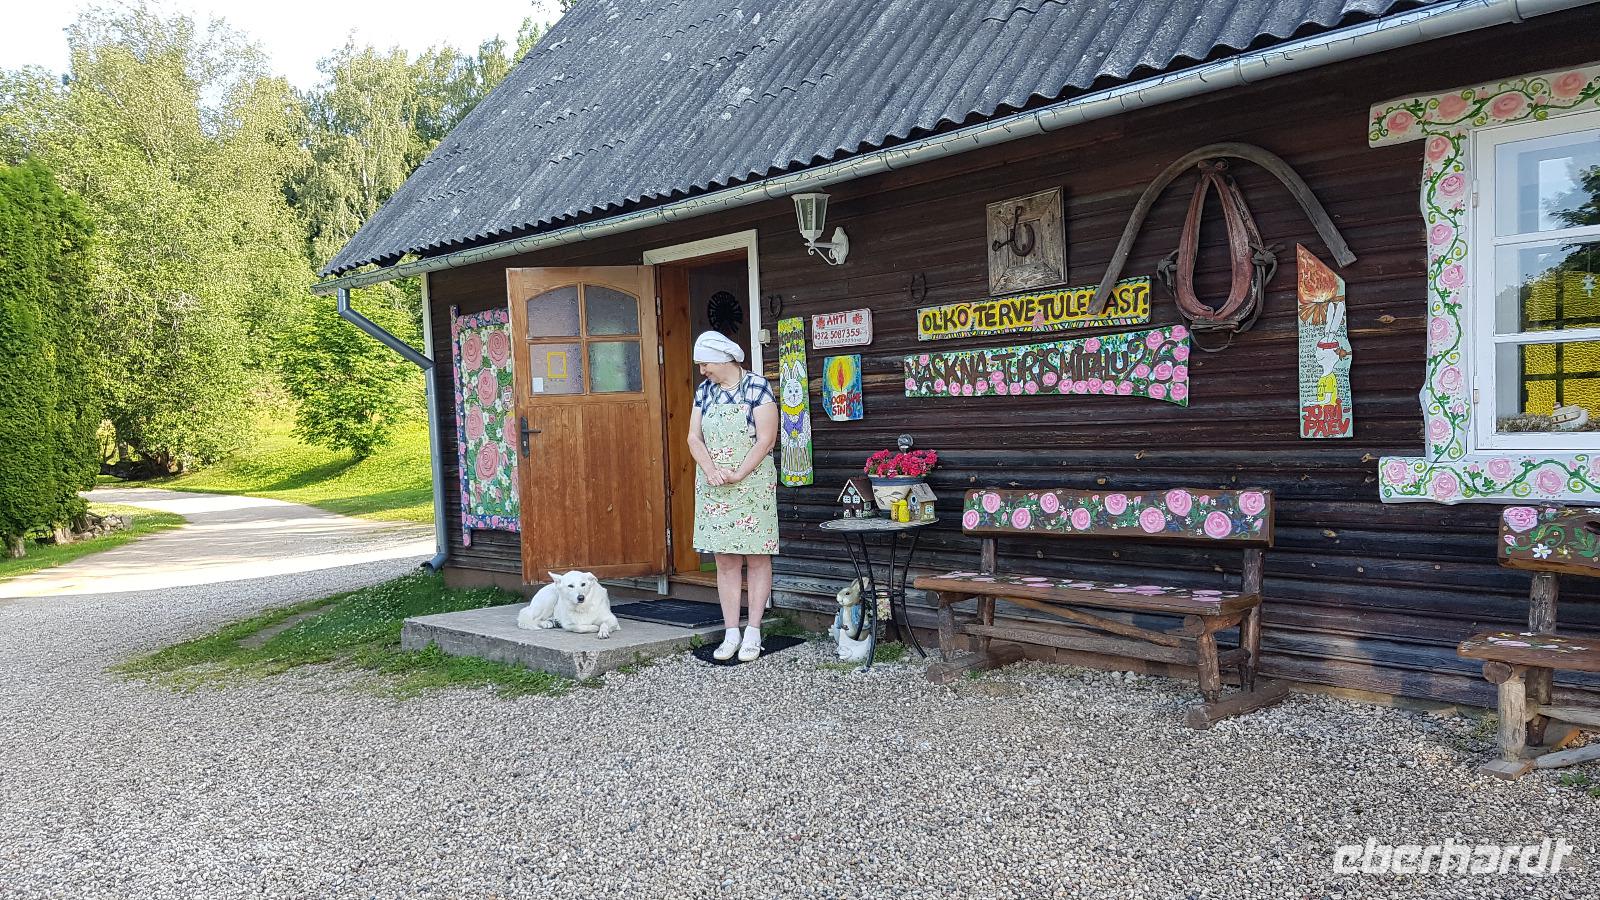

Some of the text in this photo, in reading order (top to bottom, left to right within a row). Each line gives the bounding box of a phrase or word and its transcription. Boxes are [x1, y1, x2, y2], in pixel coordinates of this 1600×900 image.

[827, 313, 847, 326] AHTI
[973, 298, 1037, 327] TERVE
[1039, 286, 1149, 321] TULEAST!
